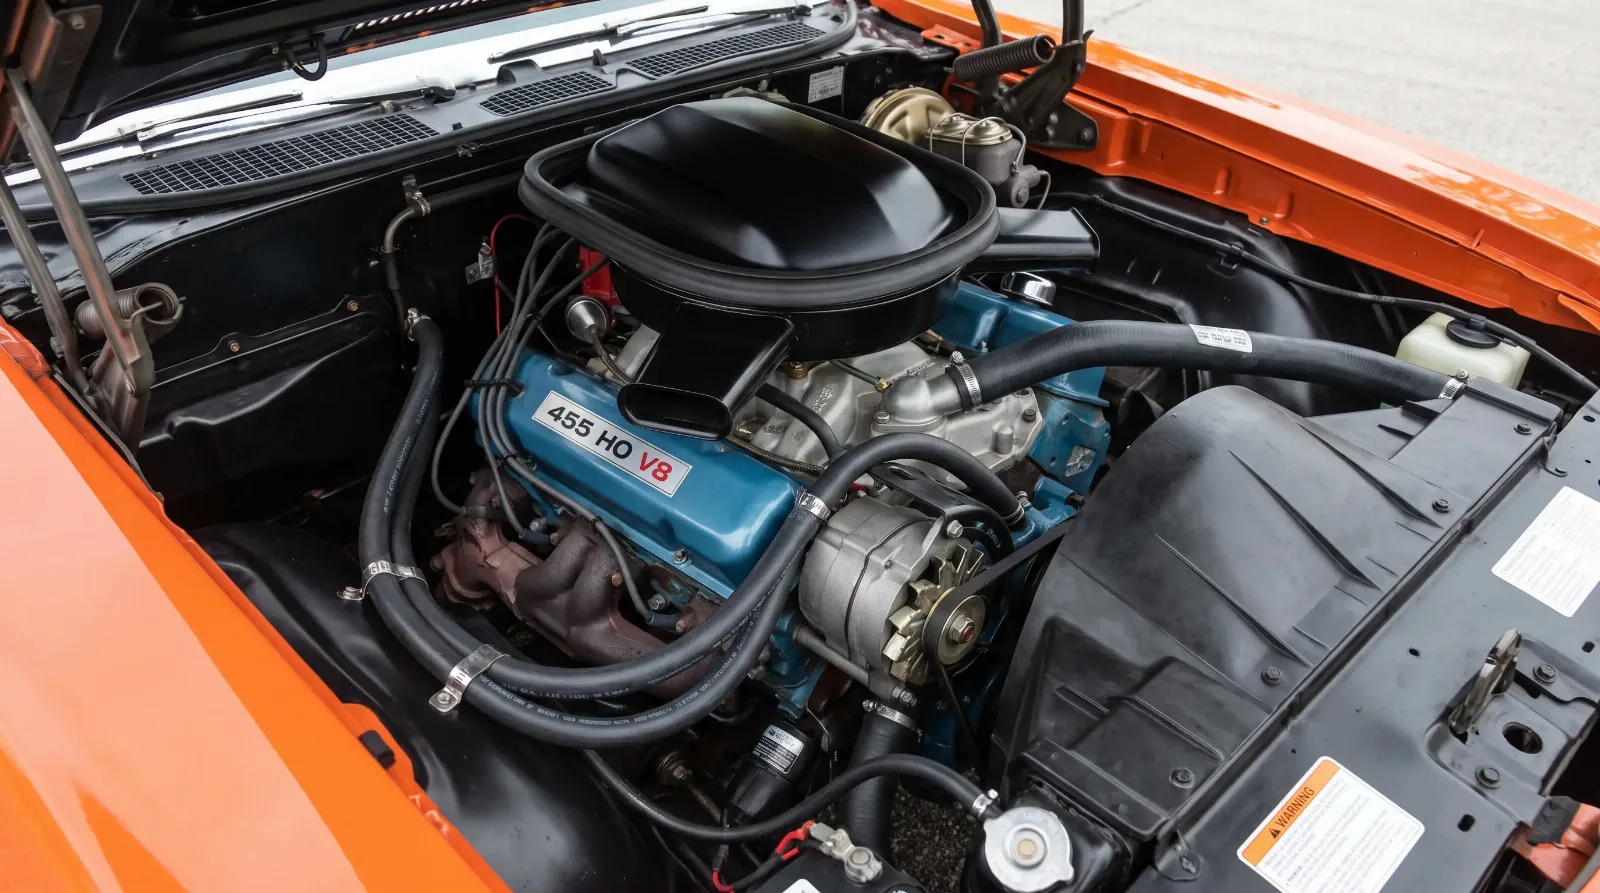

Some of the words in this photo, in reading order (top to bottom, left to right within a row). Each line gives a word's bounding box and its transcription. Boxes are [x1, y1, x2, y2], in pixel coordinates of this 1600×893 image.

[548, 406, 594, 438] 455
[595, 430, 633, 460] HO
[639, 451, 673, 482] V8
[1275, 786, 1315, 828] WARNING
